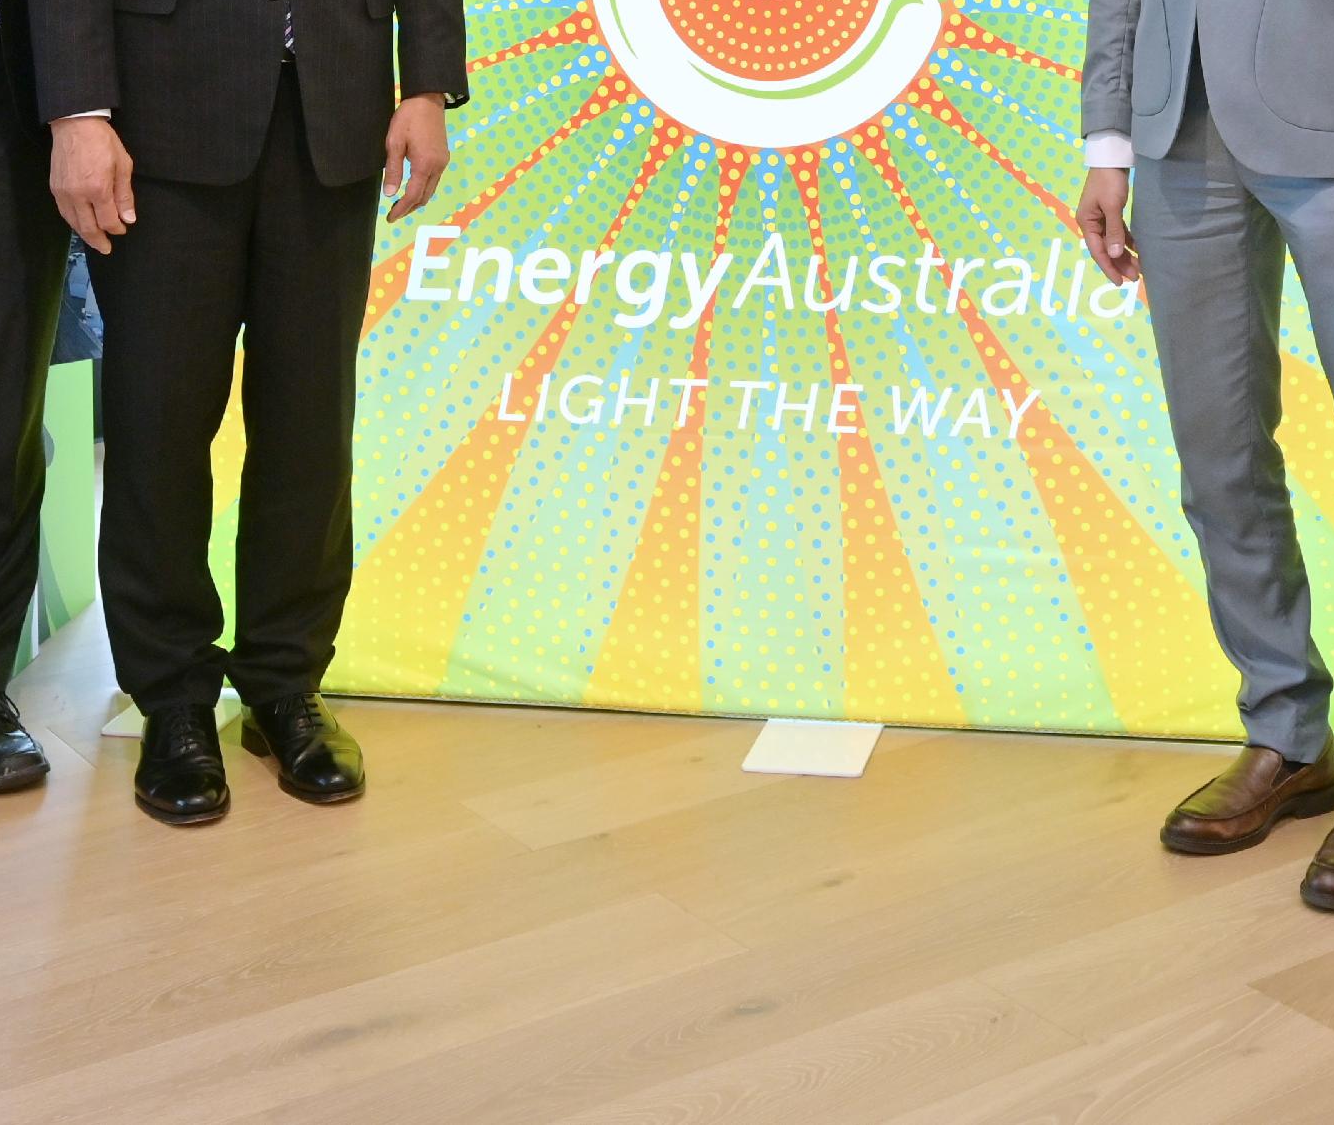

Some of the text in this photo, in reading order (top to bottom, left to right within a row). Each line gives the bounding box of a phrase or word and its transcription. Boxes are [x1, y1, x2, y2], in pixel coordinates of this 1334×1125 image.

[406, 226, 1141, 329] EnergyAustralia
[498, 376, 1041, 440] LIGHT THE WAY
